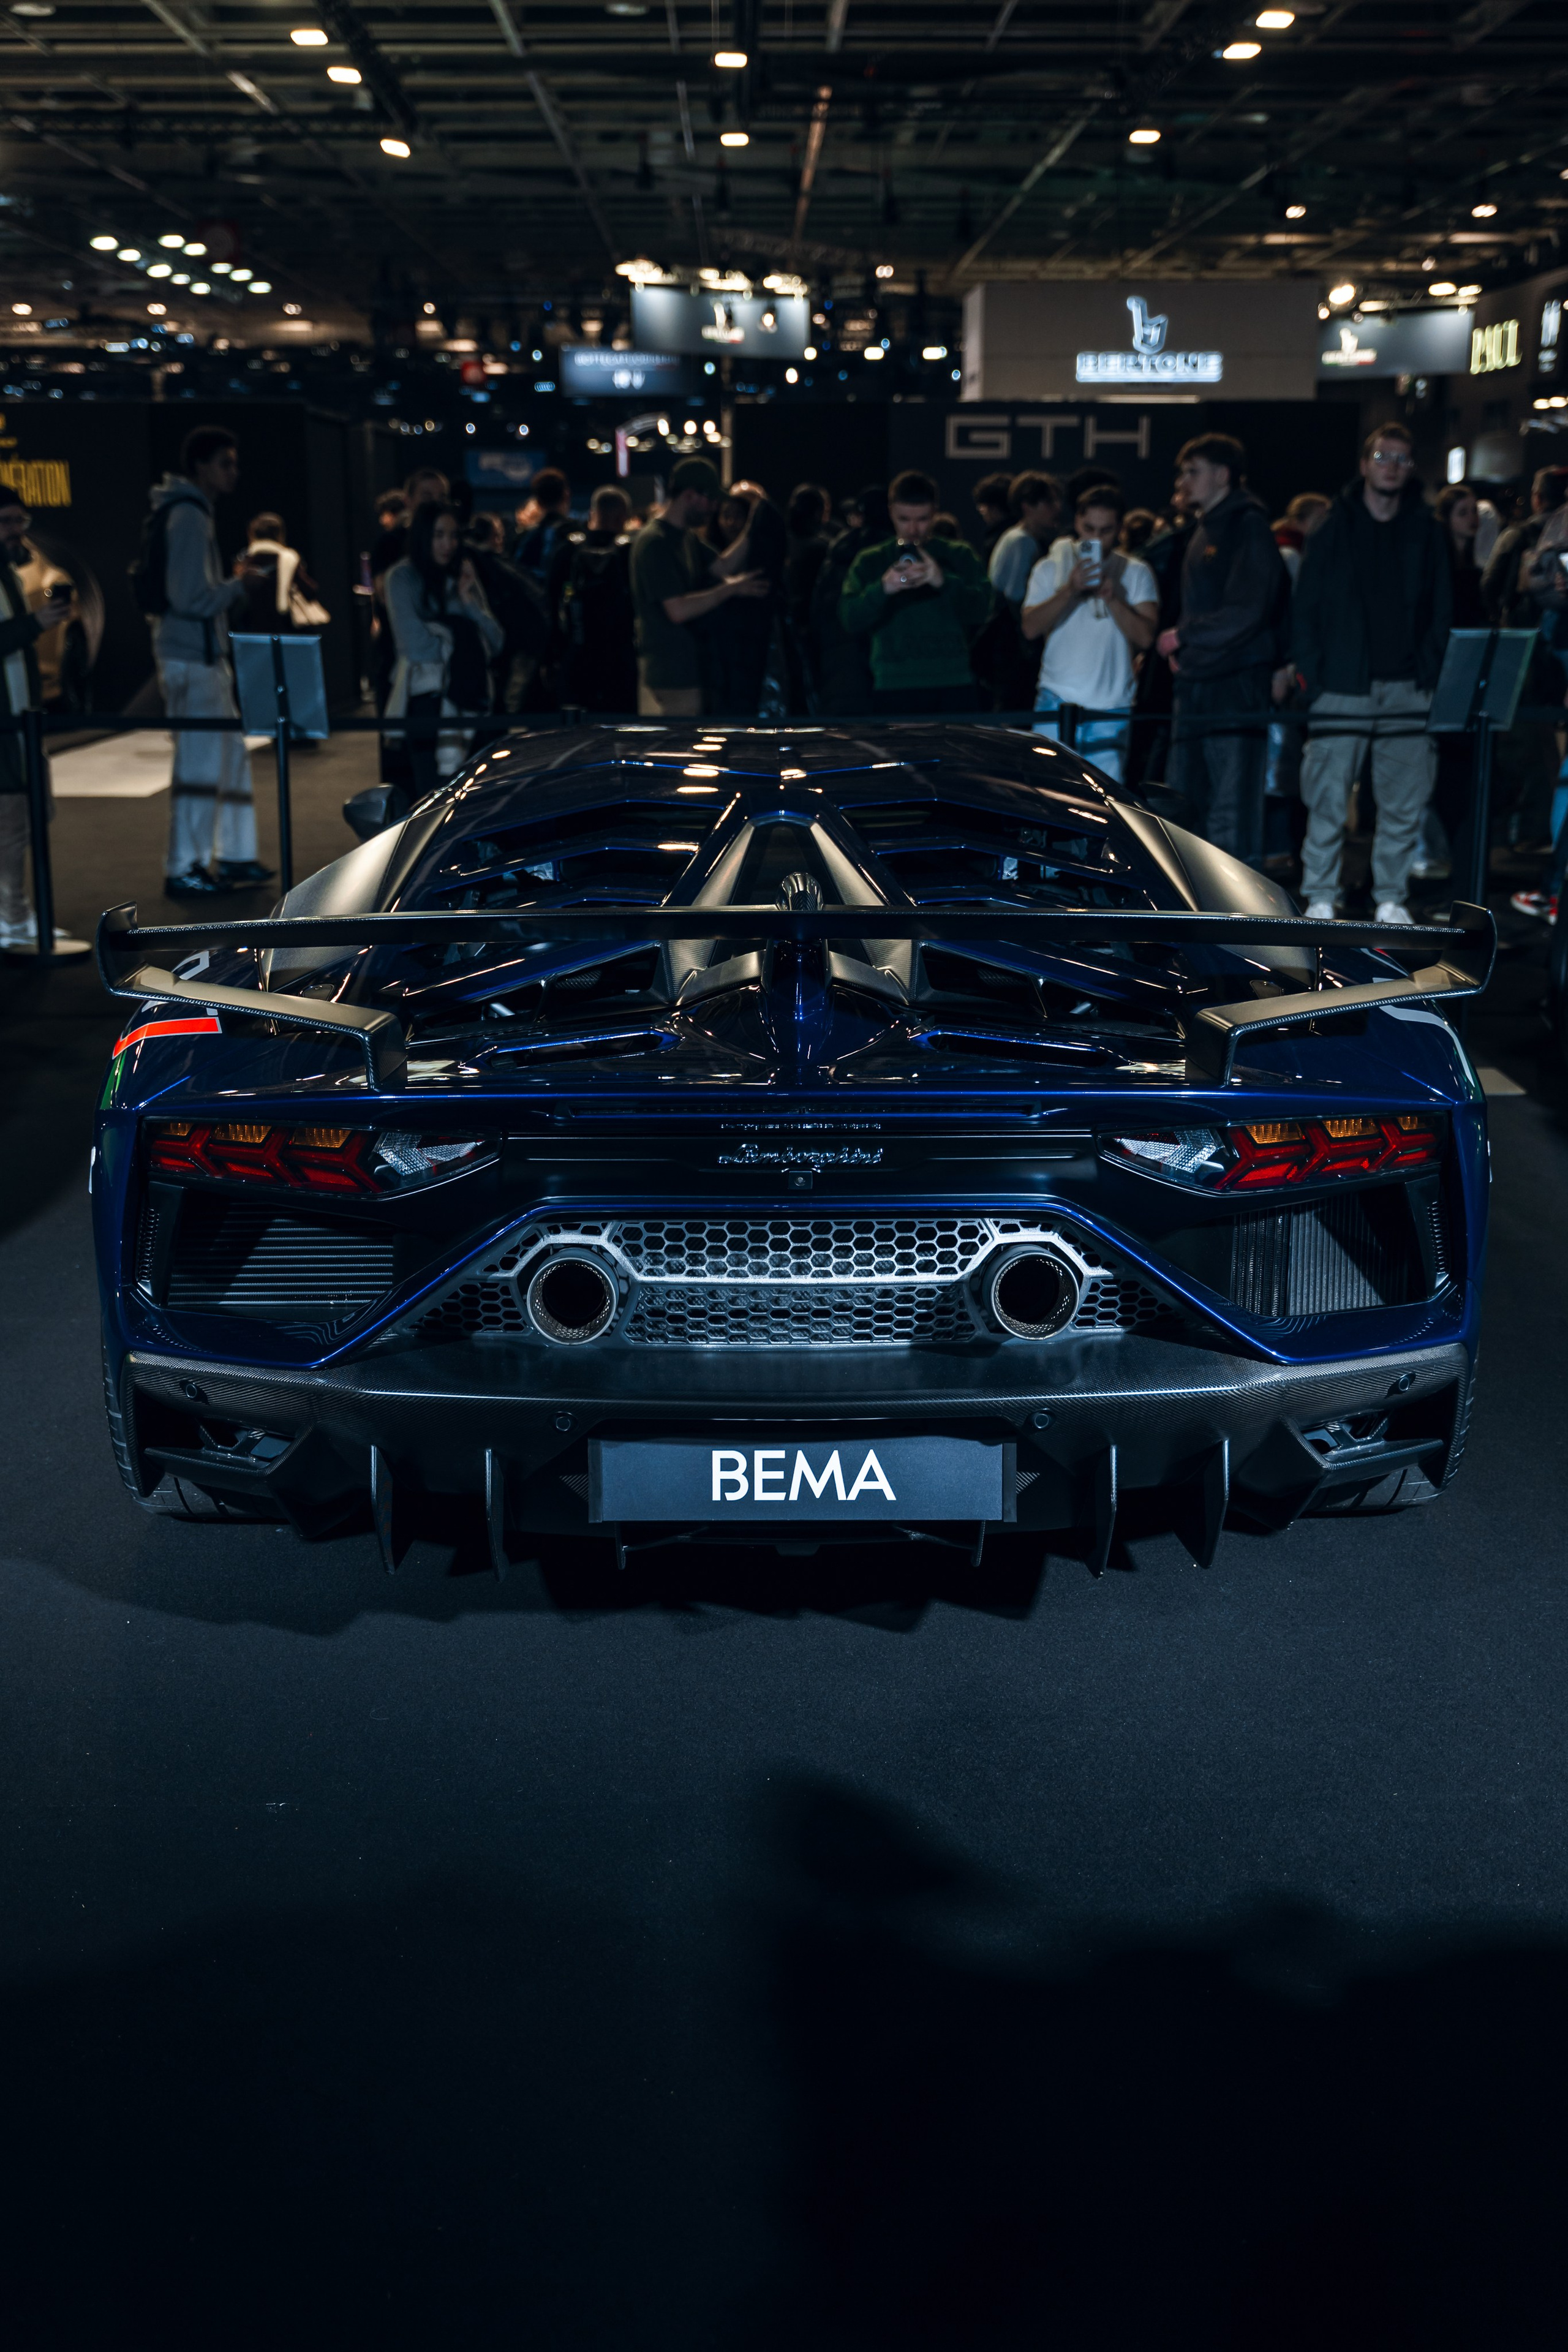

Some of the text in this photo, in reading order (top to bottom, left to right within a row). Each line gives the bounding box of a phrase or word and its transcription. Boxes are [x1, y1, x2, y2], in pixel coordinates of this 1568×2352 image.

[1470, 319, 1522, 374] PAUL
[945, 414, 1151, 459] GTH
[717, 1144, 883, 1167] Lamborghini
[712, 1449, 896, 1501] BEMA
